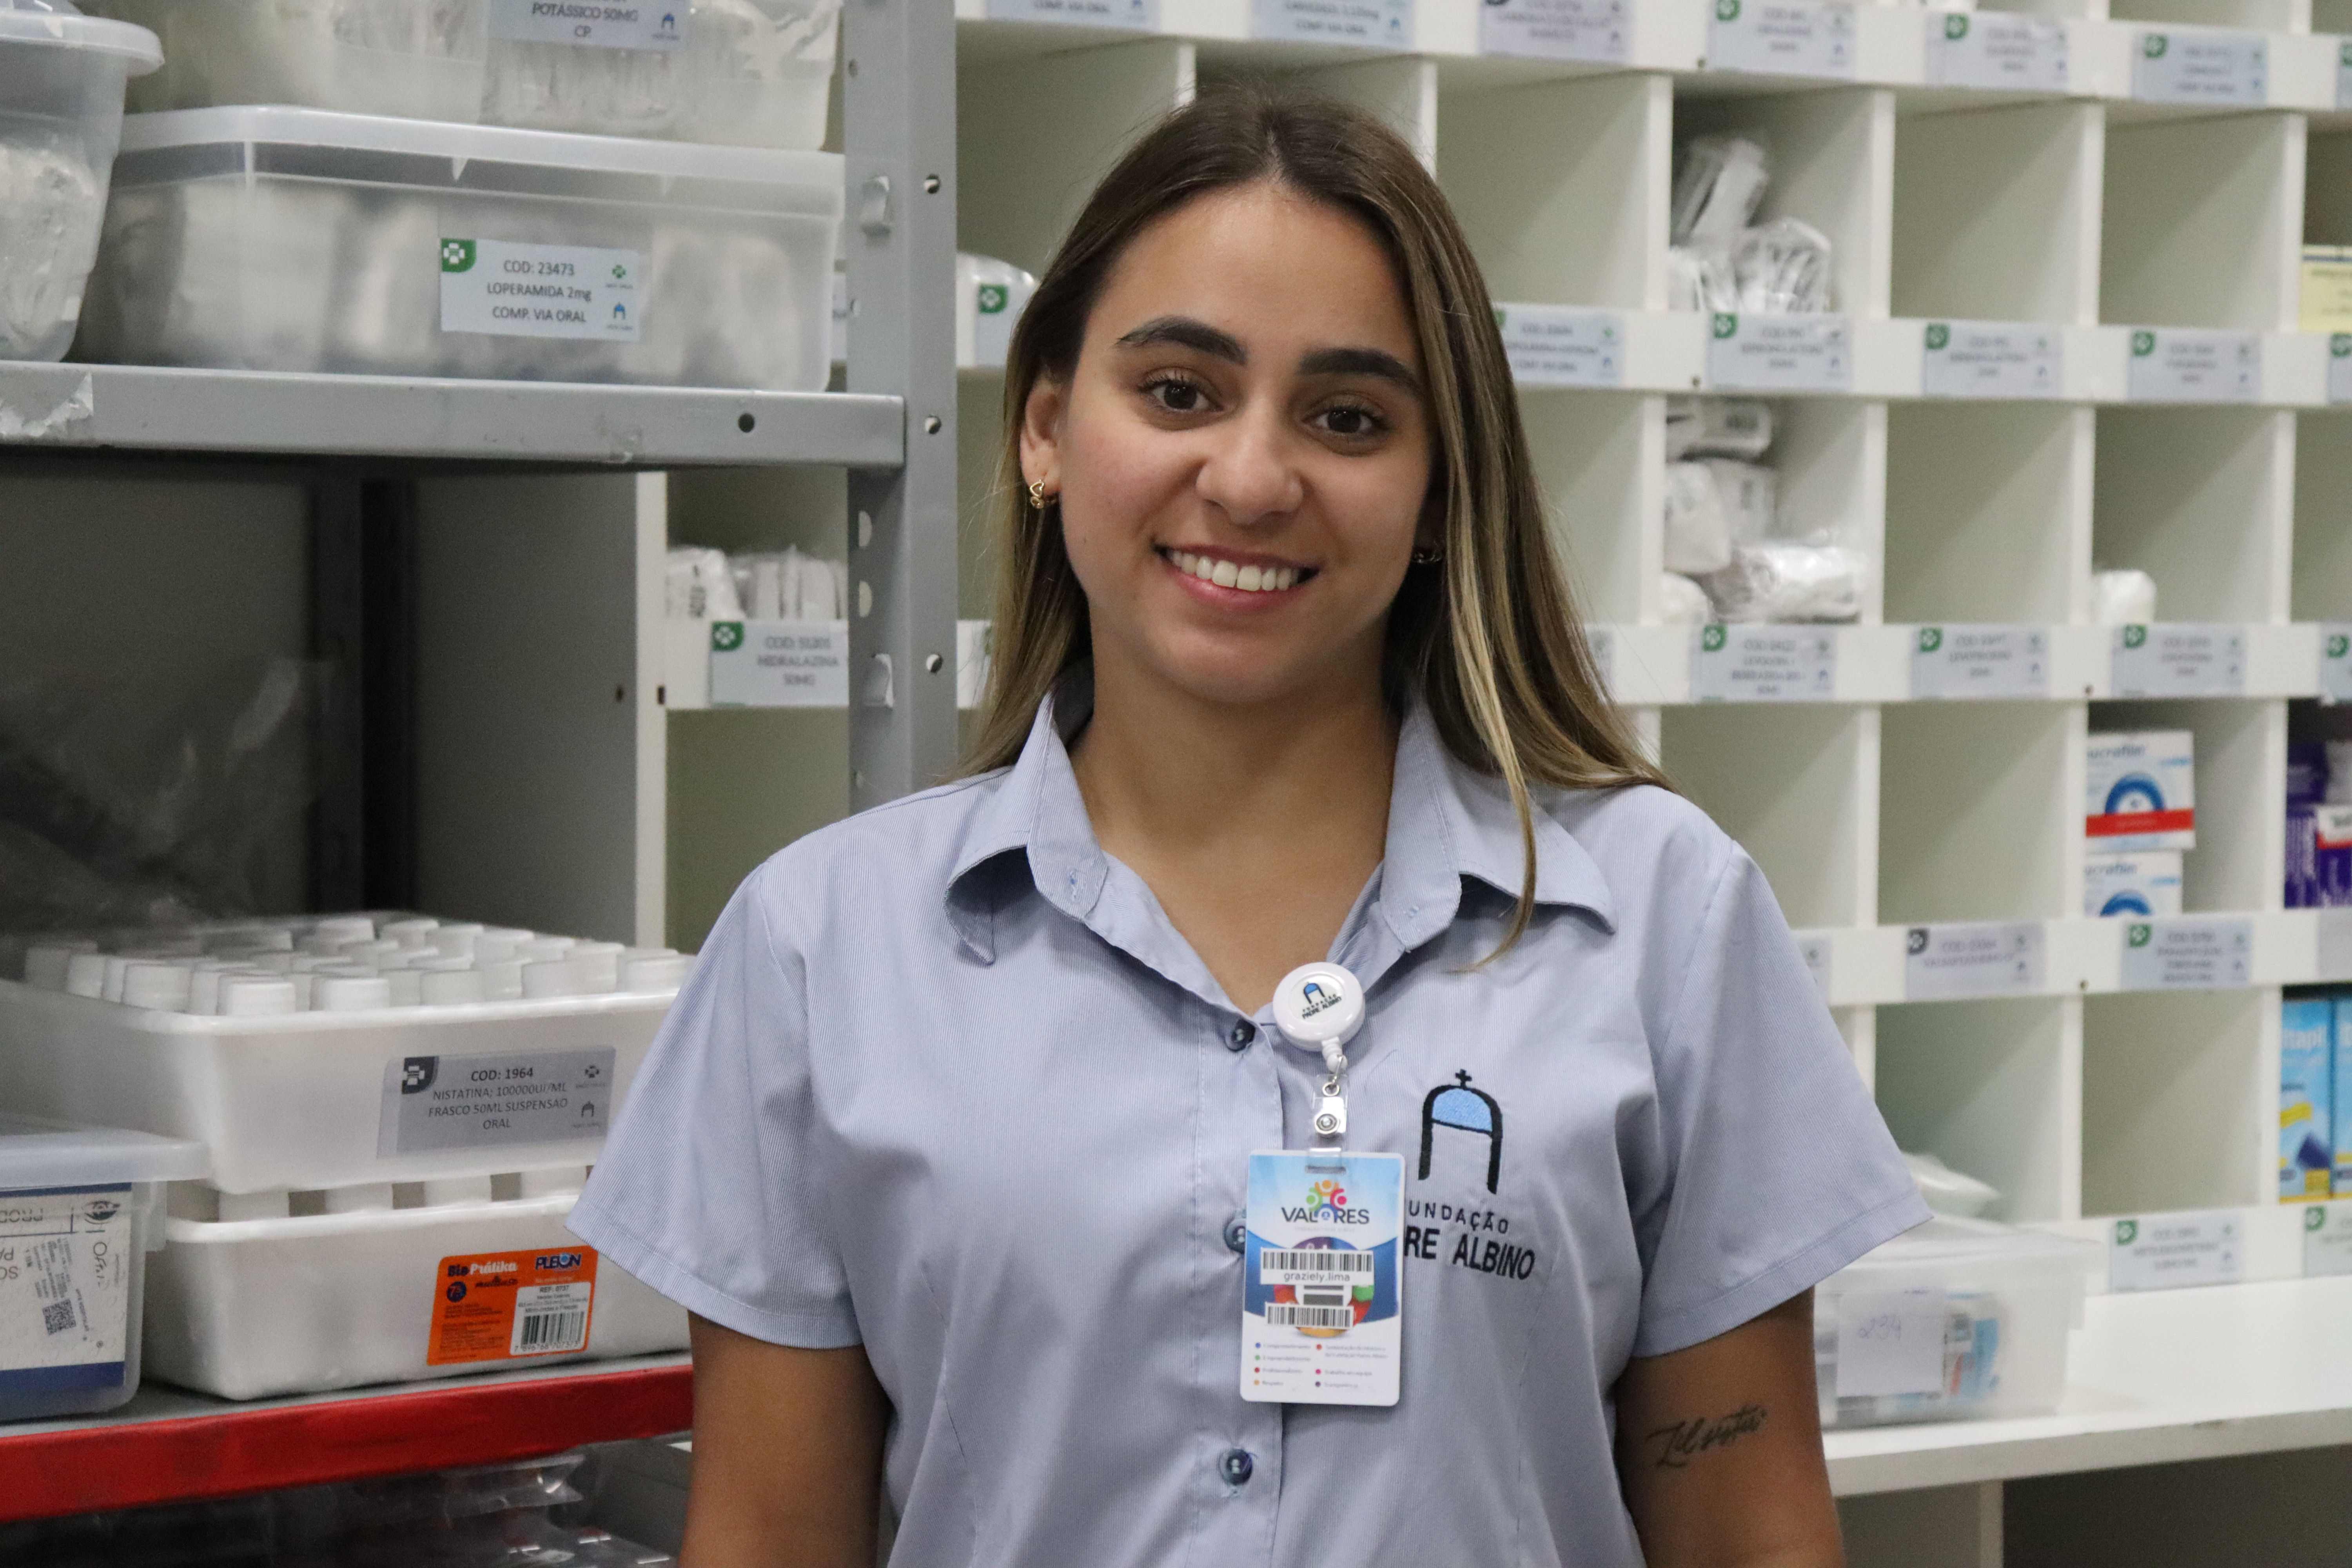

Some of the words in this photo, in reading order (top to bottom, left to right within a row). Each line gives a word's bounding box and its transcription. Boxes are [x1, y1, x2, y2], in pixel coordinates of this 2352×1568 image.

[504, 260, 535, 274] COD:
[538, 262, 575, 275] 23473
[487, 282, 564, 298] LOPERAMIDA
[567, 287, 592, 301] 2mg
[492, 306, 530, 319] COMP.
[534, 309, 554, 321] VIA
[556, 310, 587, 322] ORAL
[471, 1070, 501, 1081] COD:
[505, 1067, 534, 1079] 1964
[428, 1105, 470, 1117] FRASCO
[473, 1103, 503, 1114] 50ML
[483, 1118, 512, 1130] ORAL
[1408, 1200, 1509, 1234] UNDAÇÃO
[1403, 1226, 1440, 1259] RE
[1452, 1233, 1535, 1280] ALBINO
[1284, 1270, 1350, 1283] graziely.lima
